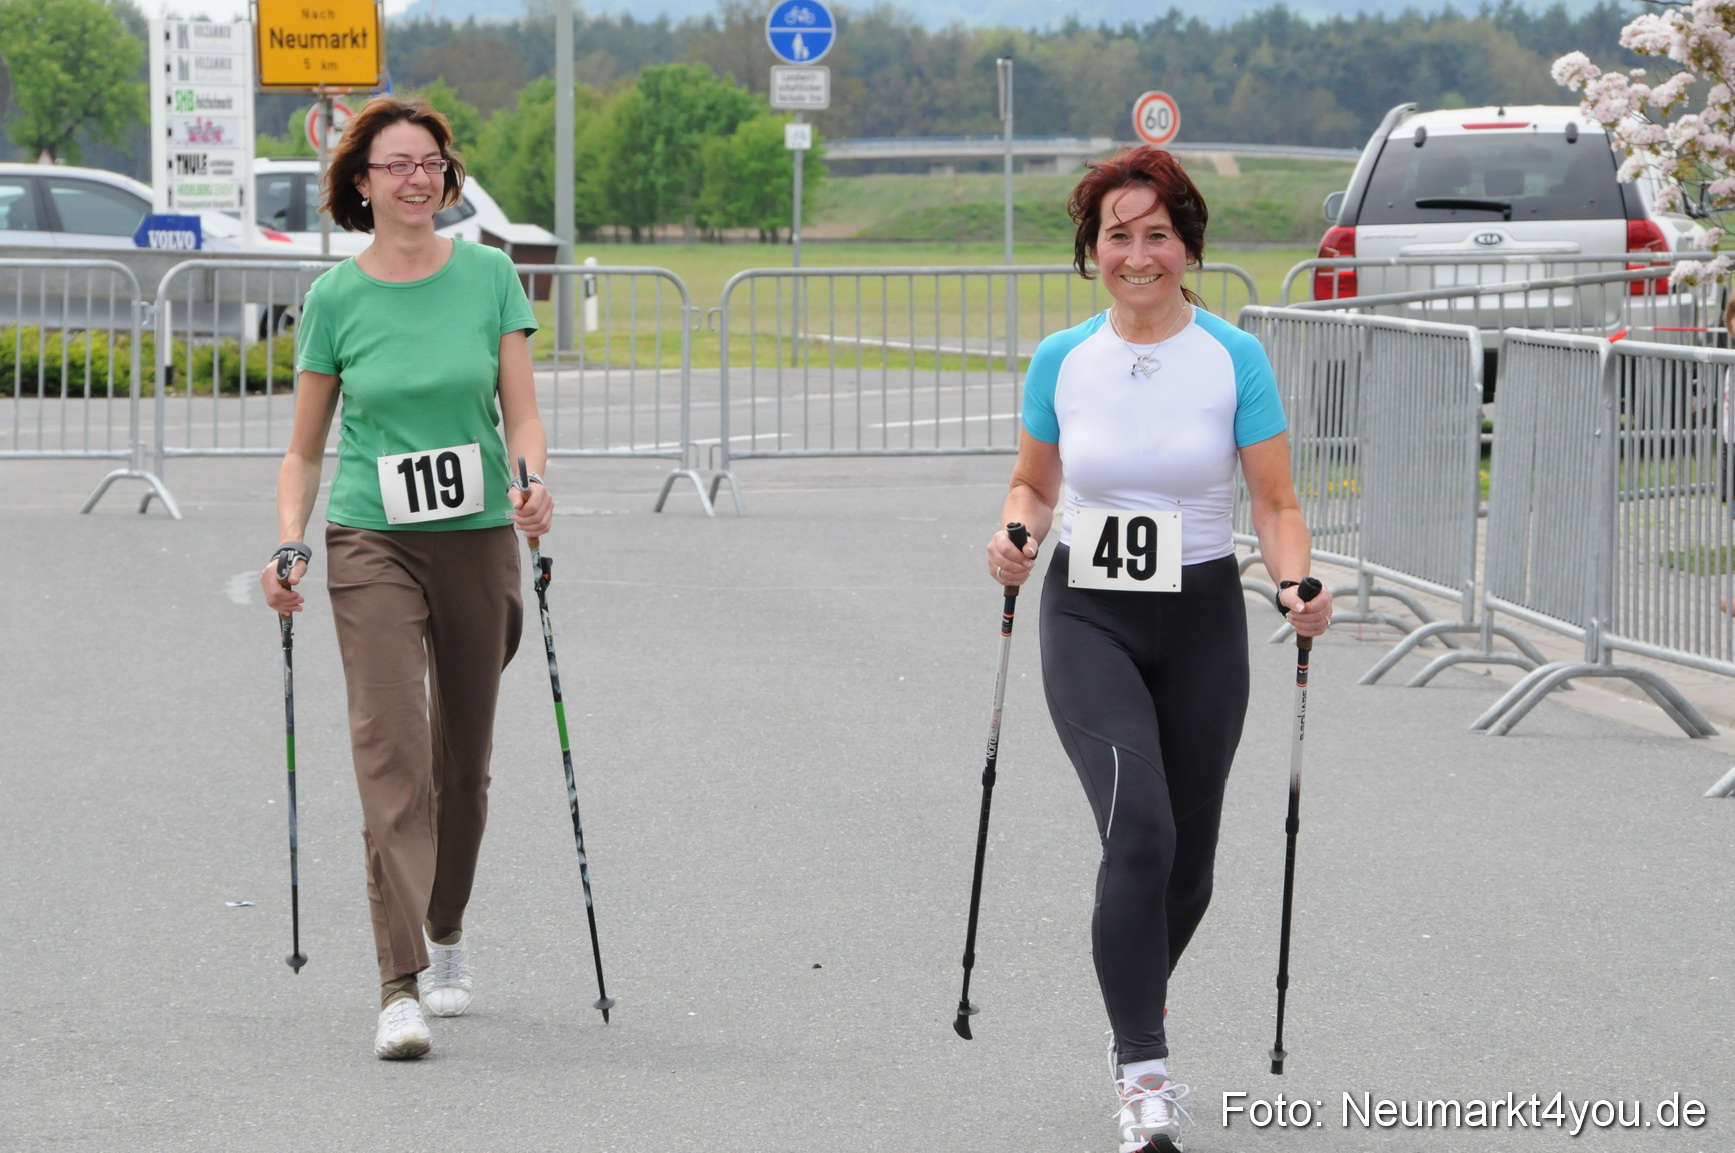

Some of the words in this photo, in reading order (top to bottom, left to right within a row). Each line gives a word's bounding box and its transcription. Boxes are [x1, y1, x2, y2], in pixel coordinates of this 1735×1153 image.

[301, 8, 335, 19] Nach
[269, 27, 368, 49] Neumarkt
[304, 58, 311, 70] 5
[320, 58, 339, 71] km
[1145, 107, 1169, 130] 60
[147, 230, 197, 250] VOLVO
[1476, 234, 1500, 244] KIA
[397, 451, 465, 513] 119
[1092, 515, 1158, 581] 49
